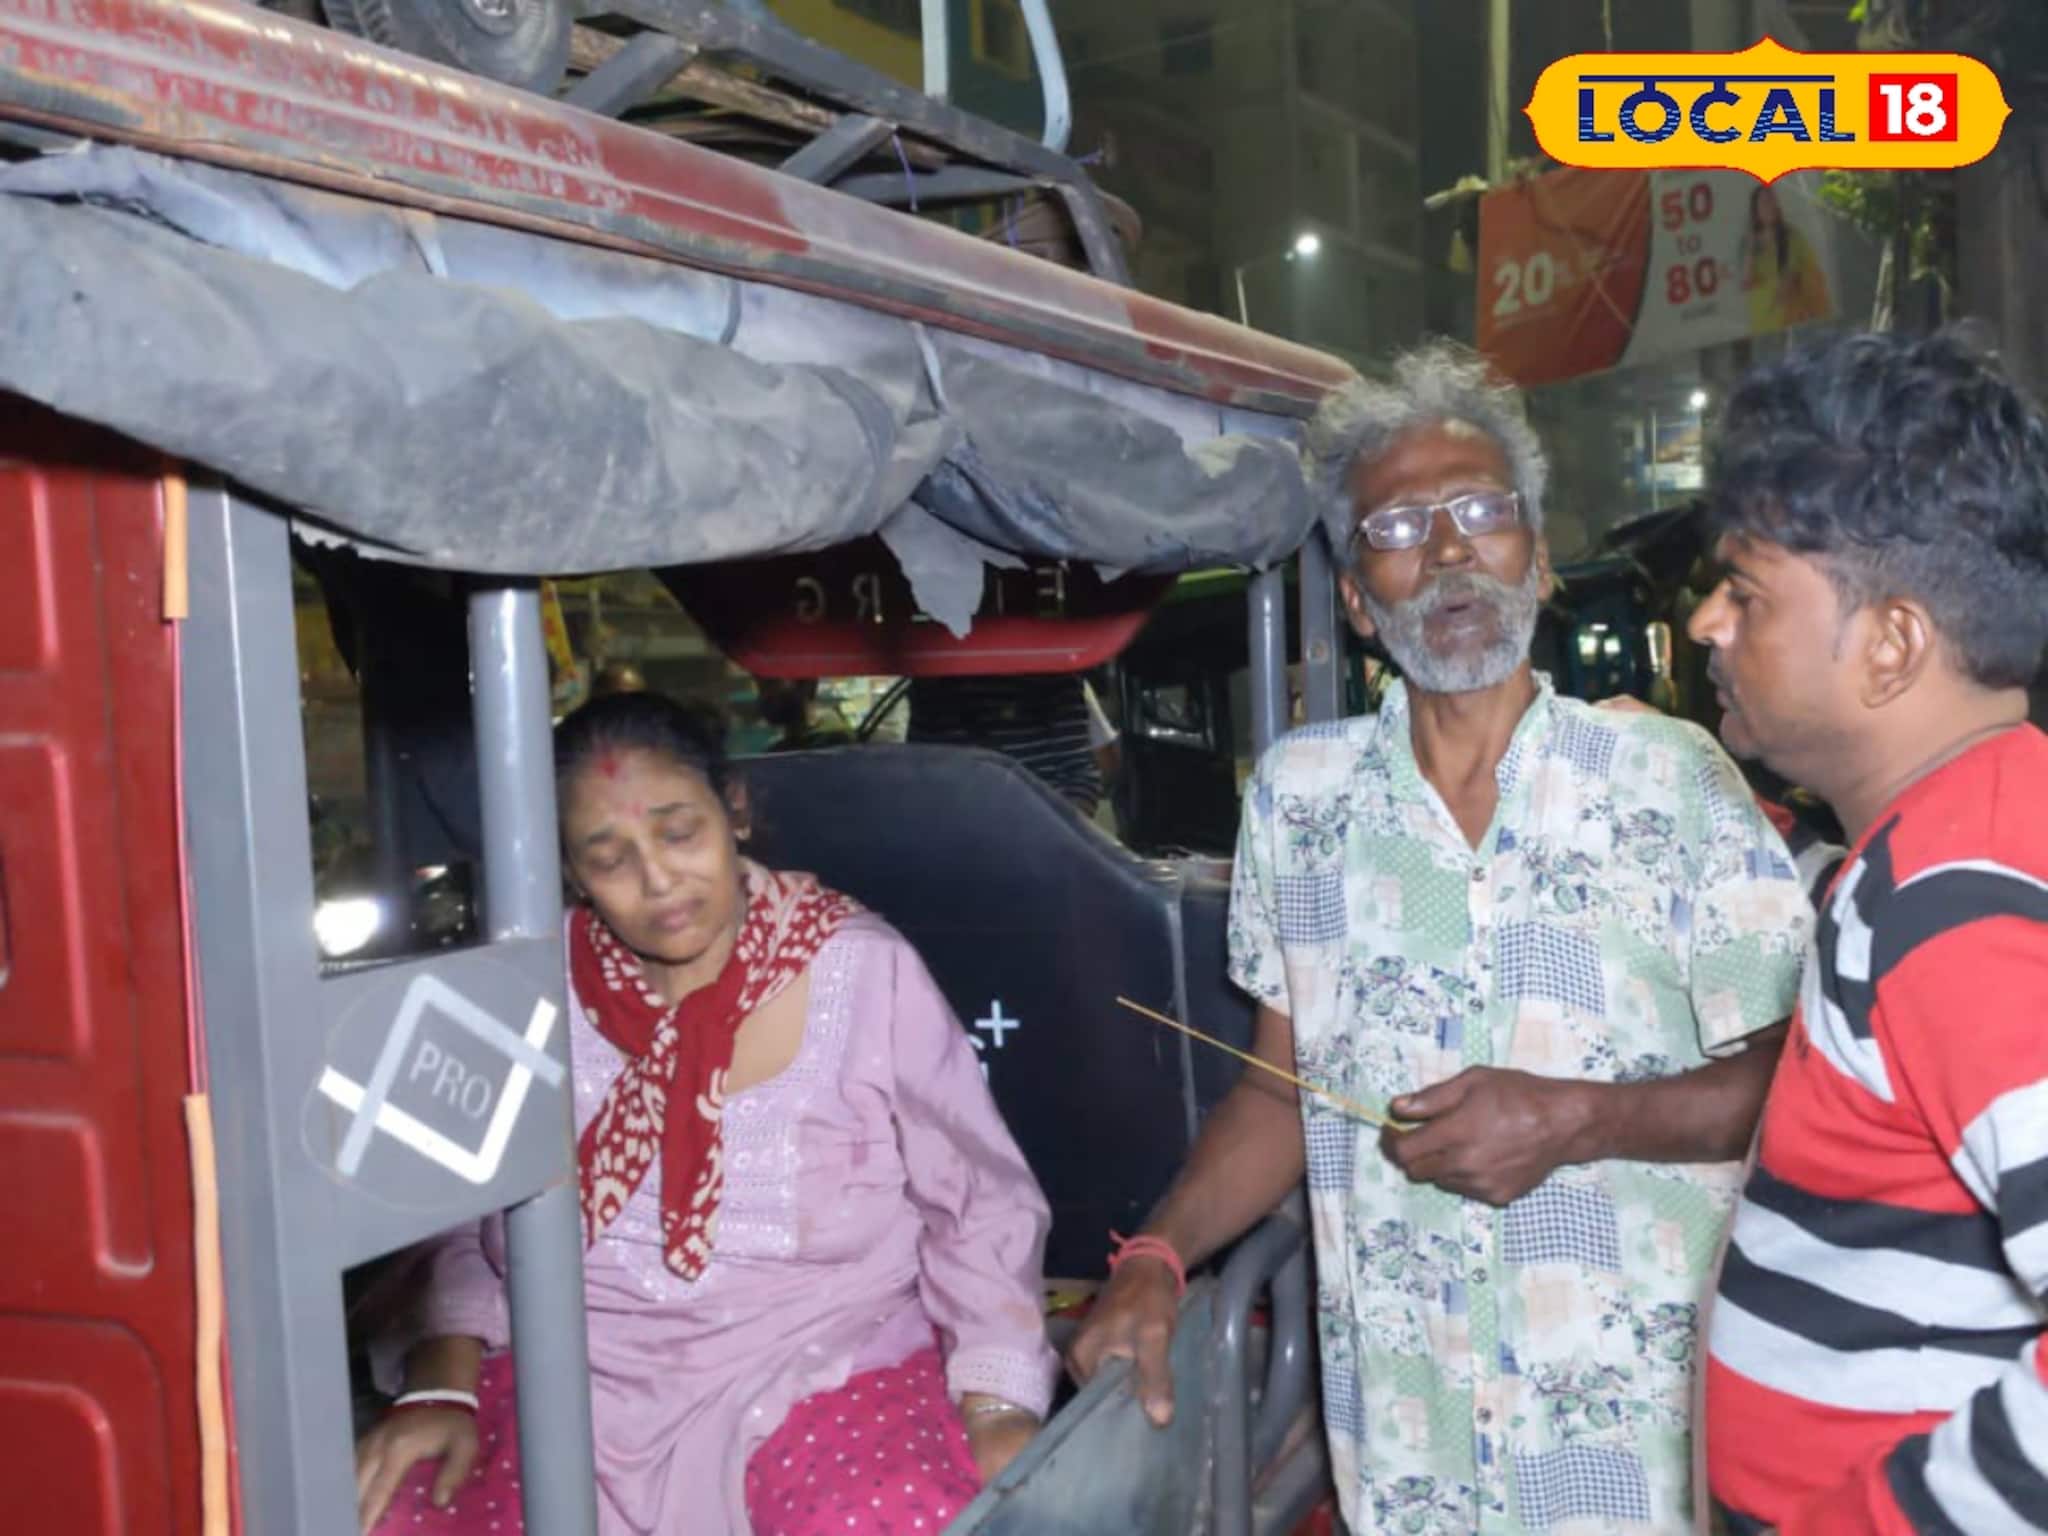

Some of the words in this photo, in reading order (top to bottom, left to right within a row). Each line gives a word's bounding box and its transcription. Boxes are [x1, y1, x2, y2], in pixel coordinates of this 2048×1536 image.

[1661, 182, 1713, 232] 50
[1677, 234, 1702, 256] to
[408, 1039, 493, 1120] PRO
